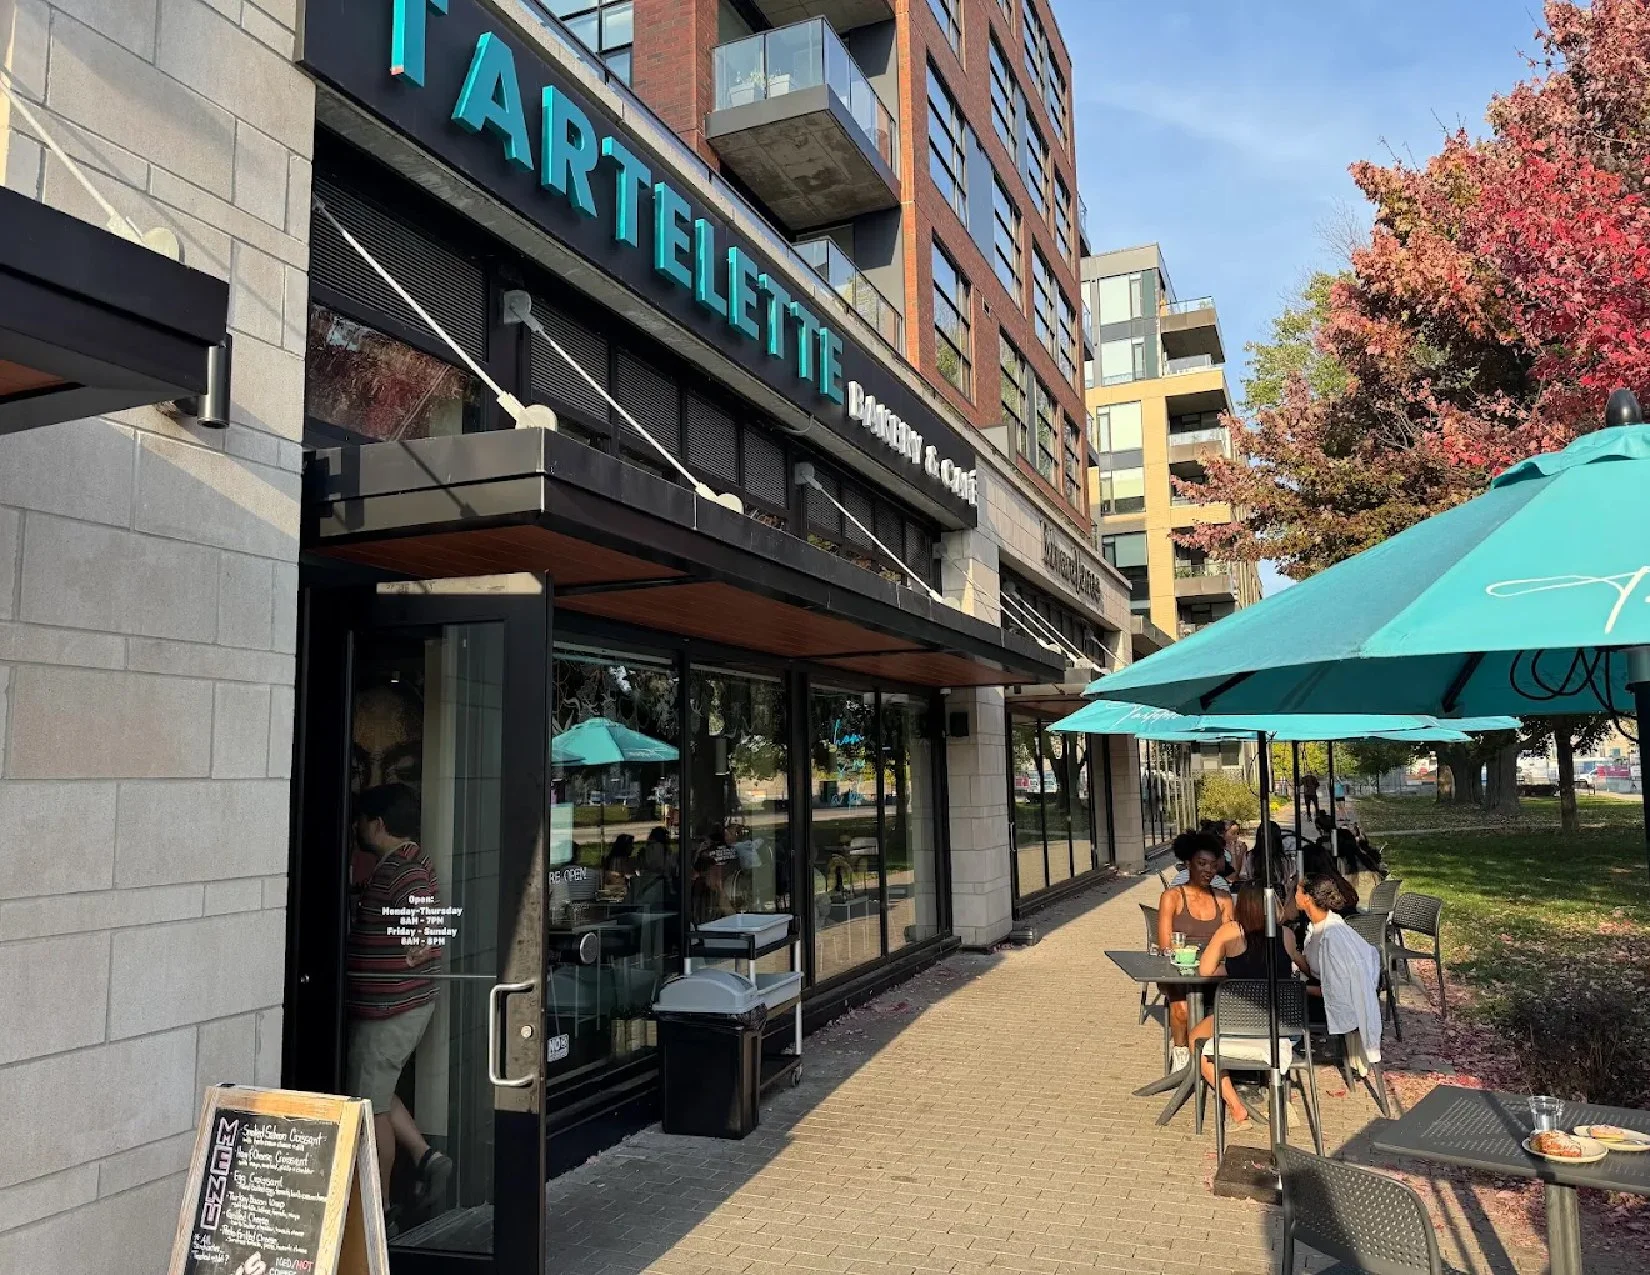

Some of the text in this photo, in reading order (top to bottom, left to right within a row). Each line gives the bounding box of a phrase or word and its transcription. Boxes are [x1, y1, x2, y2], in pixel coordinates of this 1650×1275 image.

[848, 380, 923, 465] BAKERY
[924, 445, 941, 479] &
[408, 895, 435, 905] Open:
[386, 926, 416, 937] Friday
[424, 926, 457, 937] Sunday
